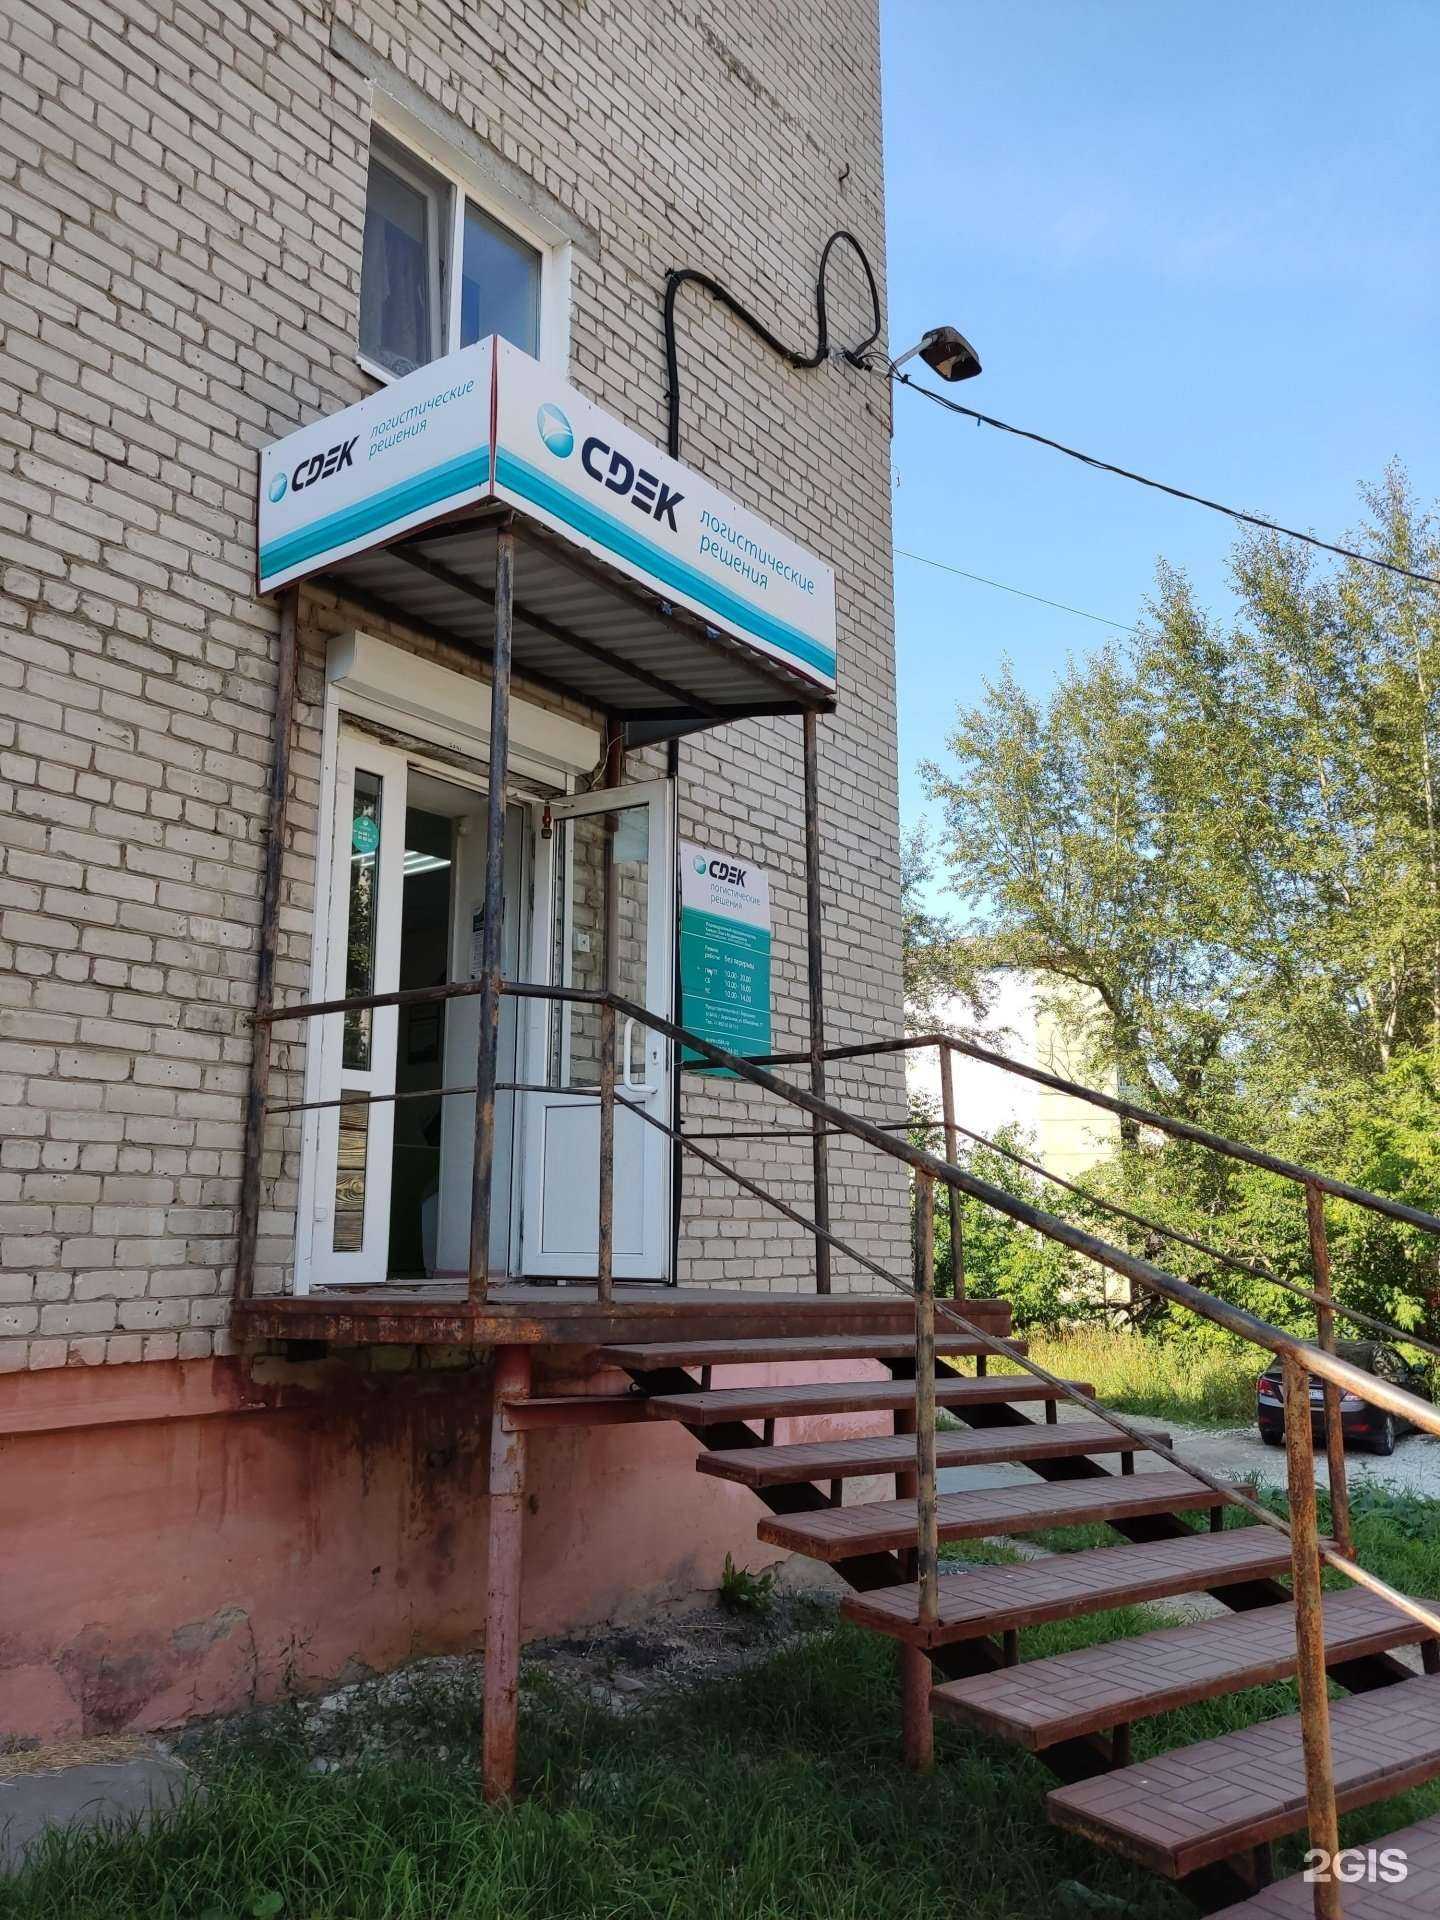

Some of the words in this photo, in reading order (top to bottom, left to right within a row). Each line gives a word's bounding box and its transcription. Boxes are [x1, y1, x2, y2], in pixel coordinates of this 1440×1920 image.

[370, 378, 475, 438] логистические
[291, 434, 361, 492] CDEK
[368, 418, 428, 460] решения
[581, 437, 685, 533] CDEK
[700, 510, 815, 595] логистические
[700, 535, 769, 590] решения
[709, 860, 747, 888] CDEK
